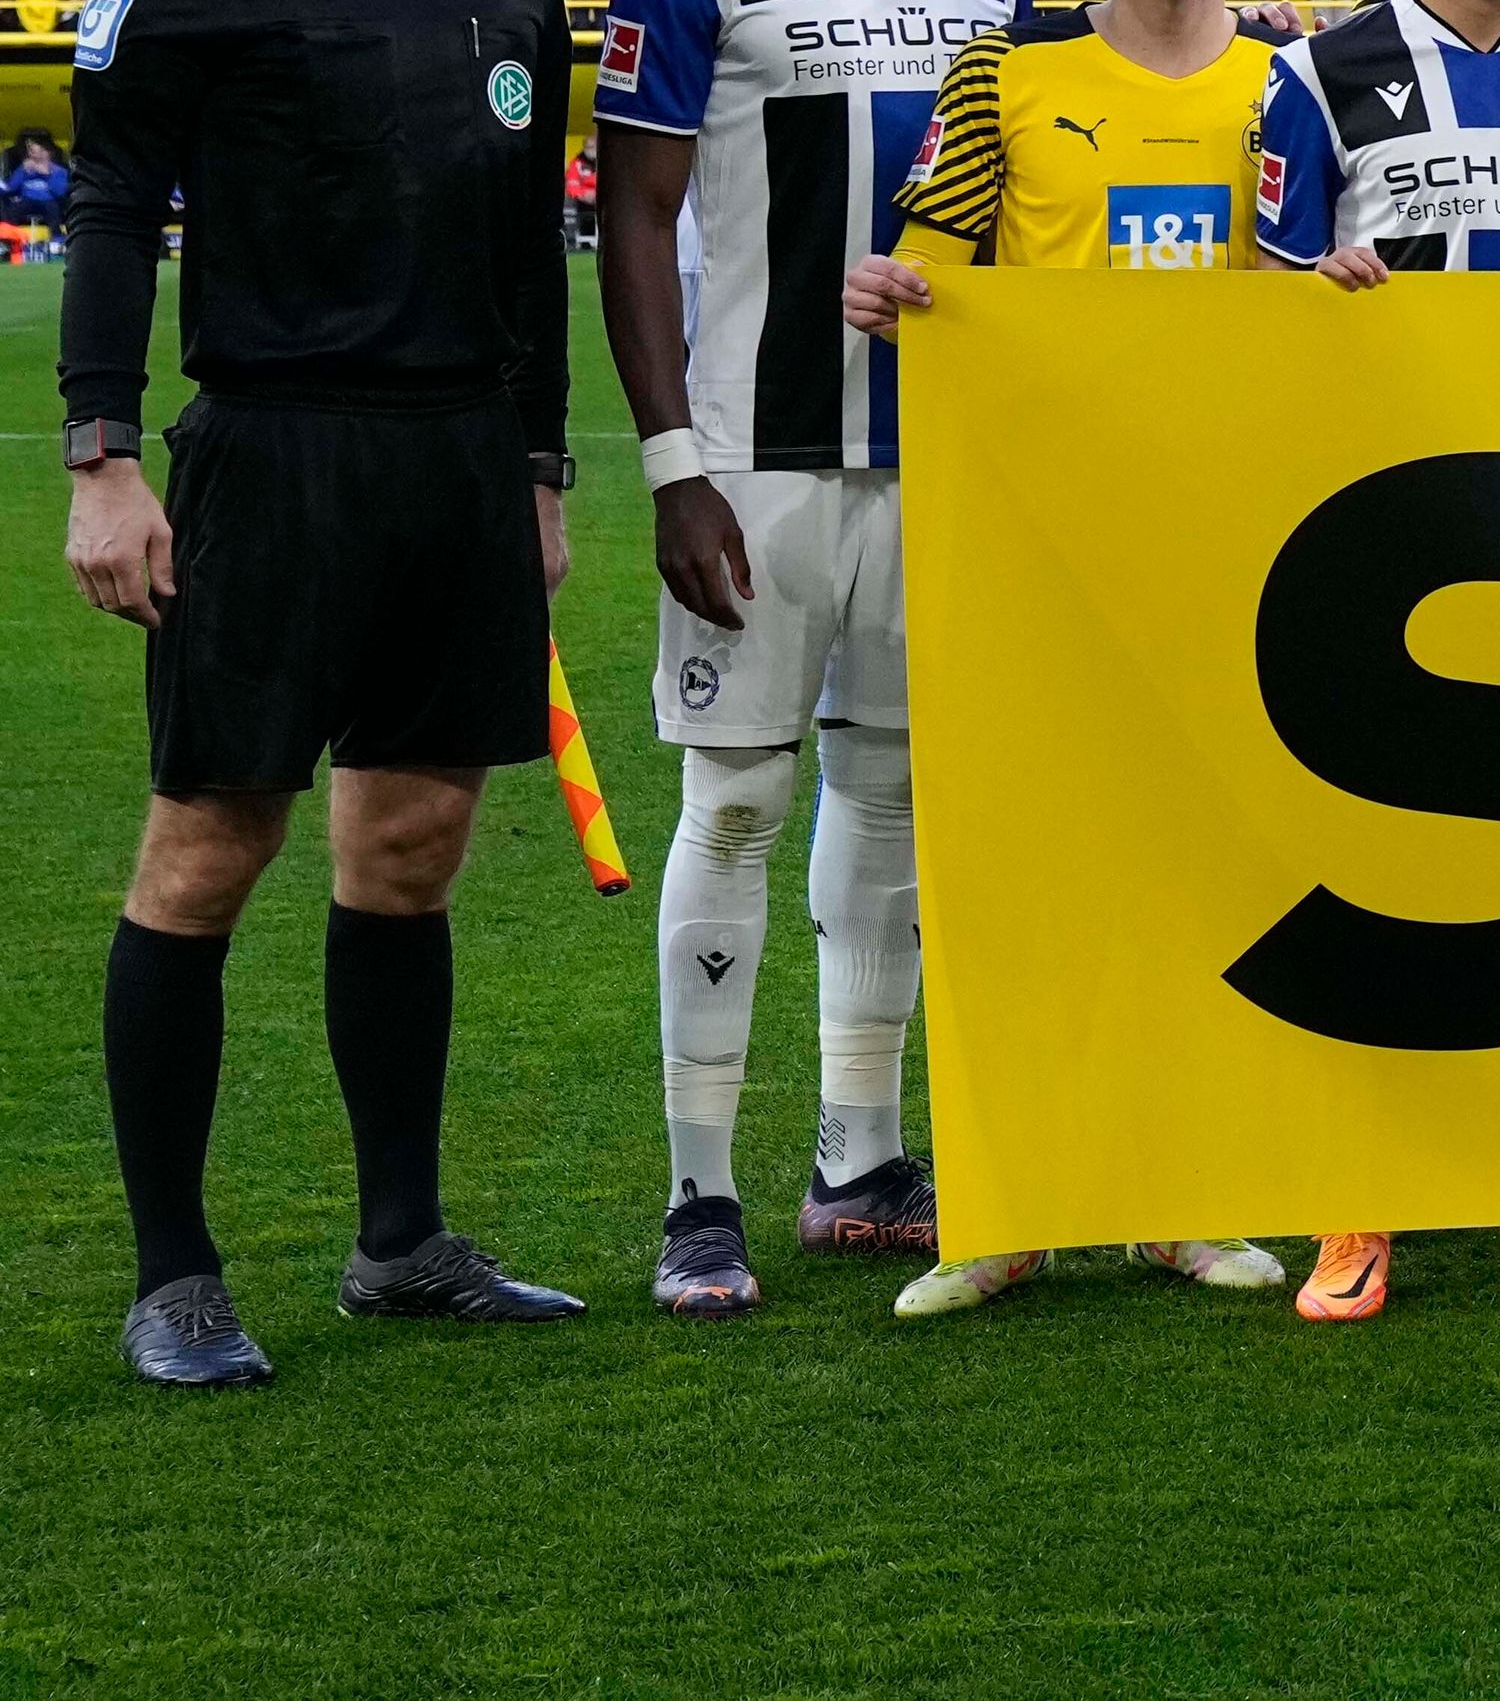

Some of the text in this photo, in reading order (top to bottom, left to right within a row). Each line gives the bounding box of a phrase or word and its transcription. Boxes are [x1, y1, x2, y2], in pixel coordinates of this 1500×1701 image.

[793, 57, 884, 81] Fenster
[892, 54, 935, 75] und
[1395, 198, 1485, 223] Fenster
[1119, 213, 1216, 269] 1&1
